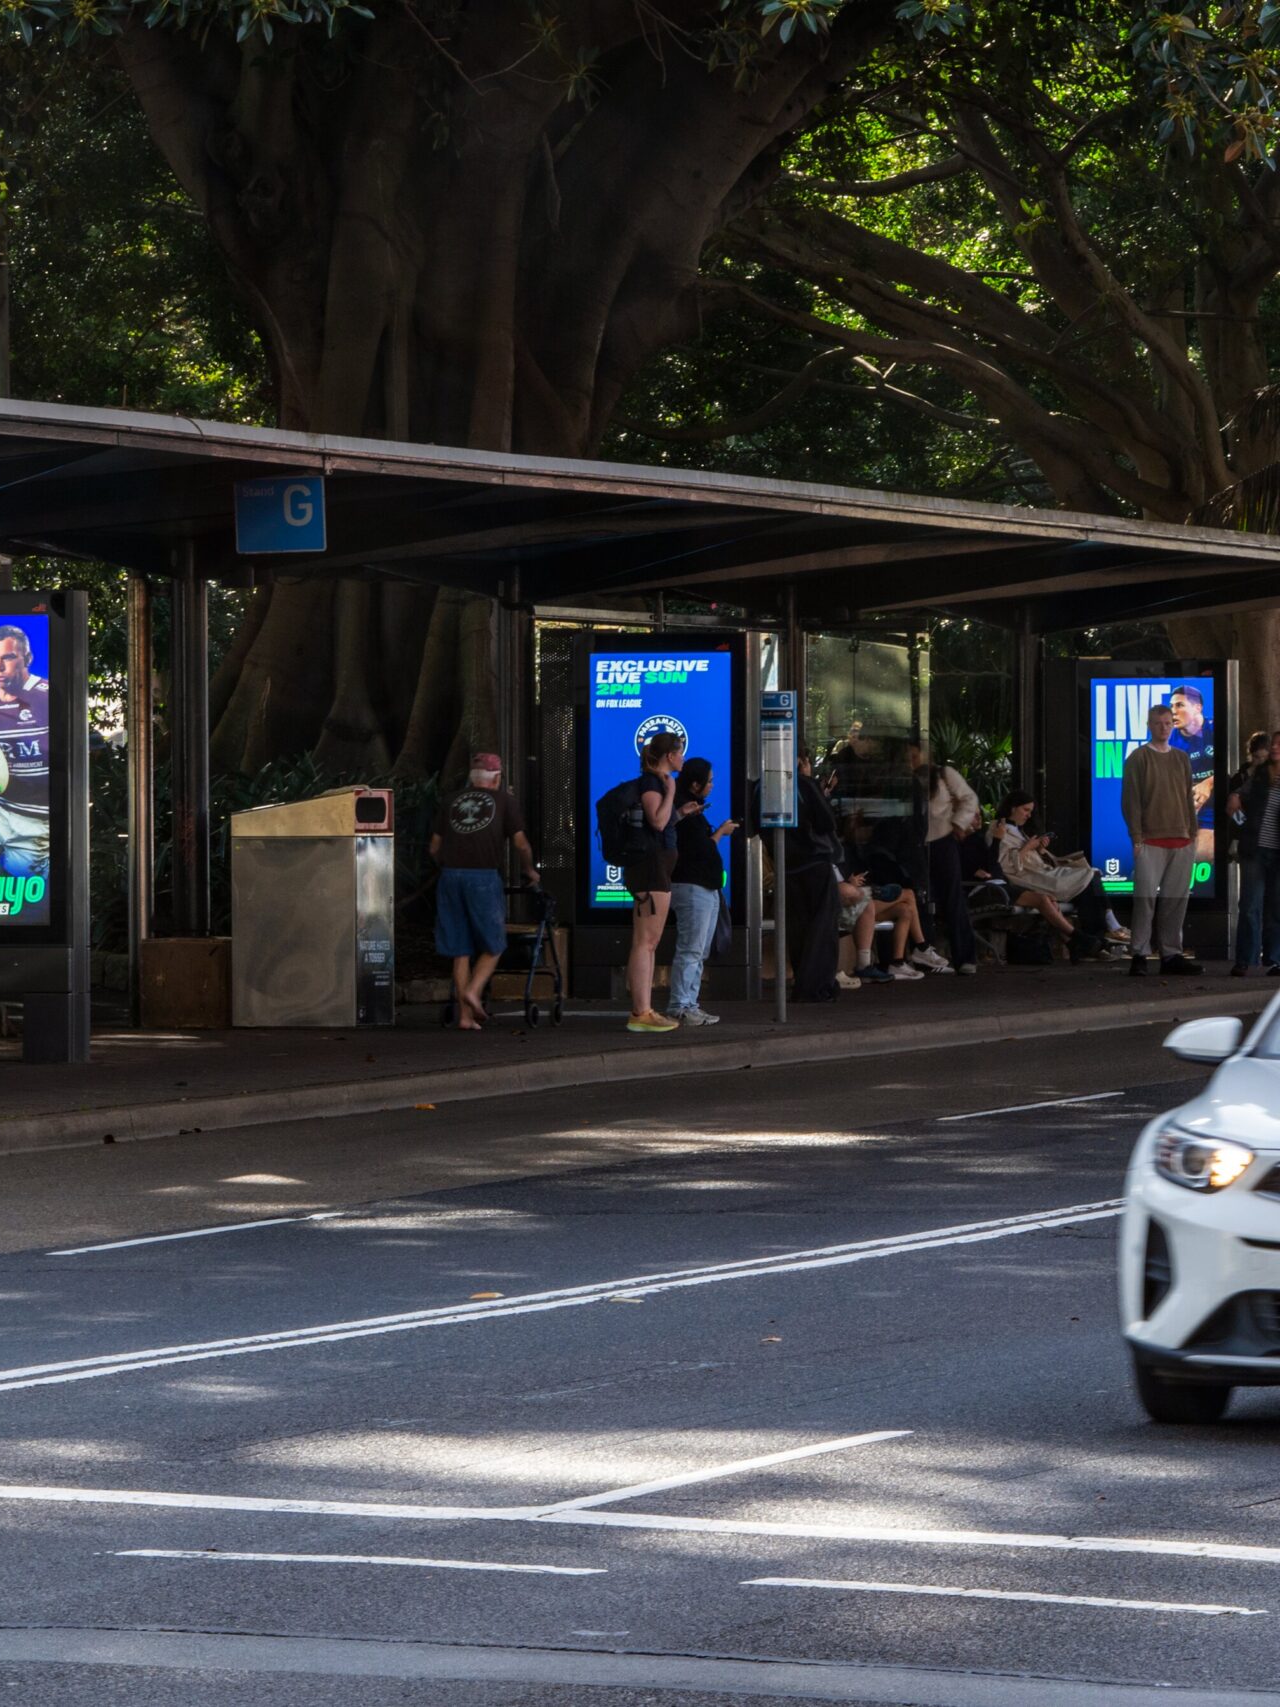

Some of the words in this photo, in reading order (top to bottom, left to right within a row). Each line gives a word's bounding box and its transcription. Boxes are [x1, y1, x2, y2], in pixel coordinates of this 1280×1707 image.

[283, 484, 313, 527] G
[596, 660, 709, 672] EXCLUSIVE
[596, 672, 641, 684] LIVE
[644, 671, 688, 683] SUN
[596, 683, 641, 695] 2PM
[618, 699, 642, 708] LEAGUE
[780, 694, 790, 706] G
[638, 717, 684, 737] PARRAMATTA
[1095, 741, 1123, 778] IN
